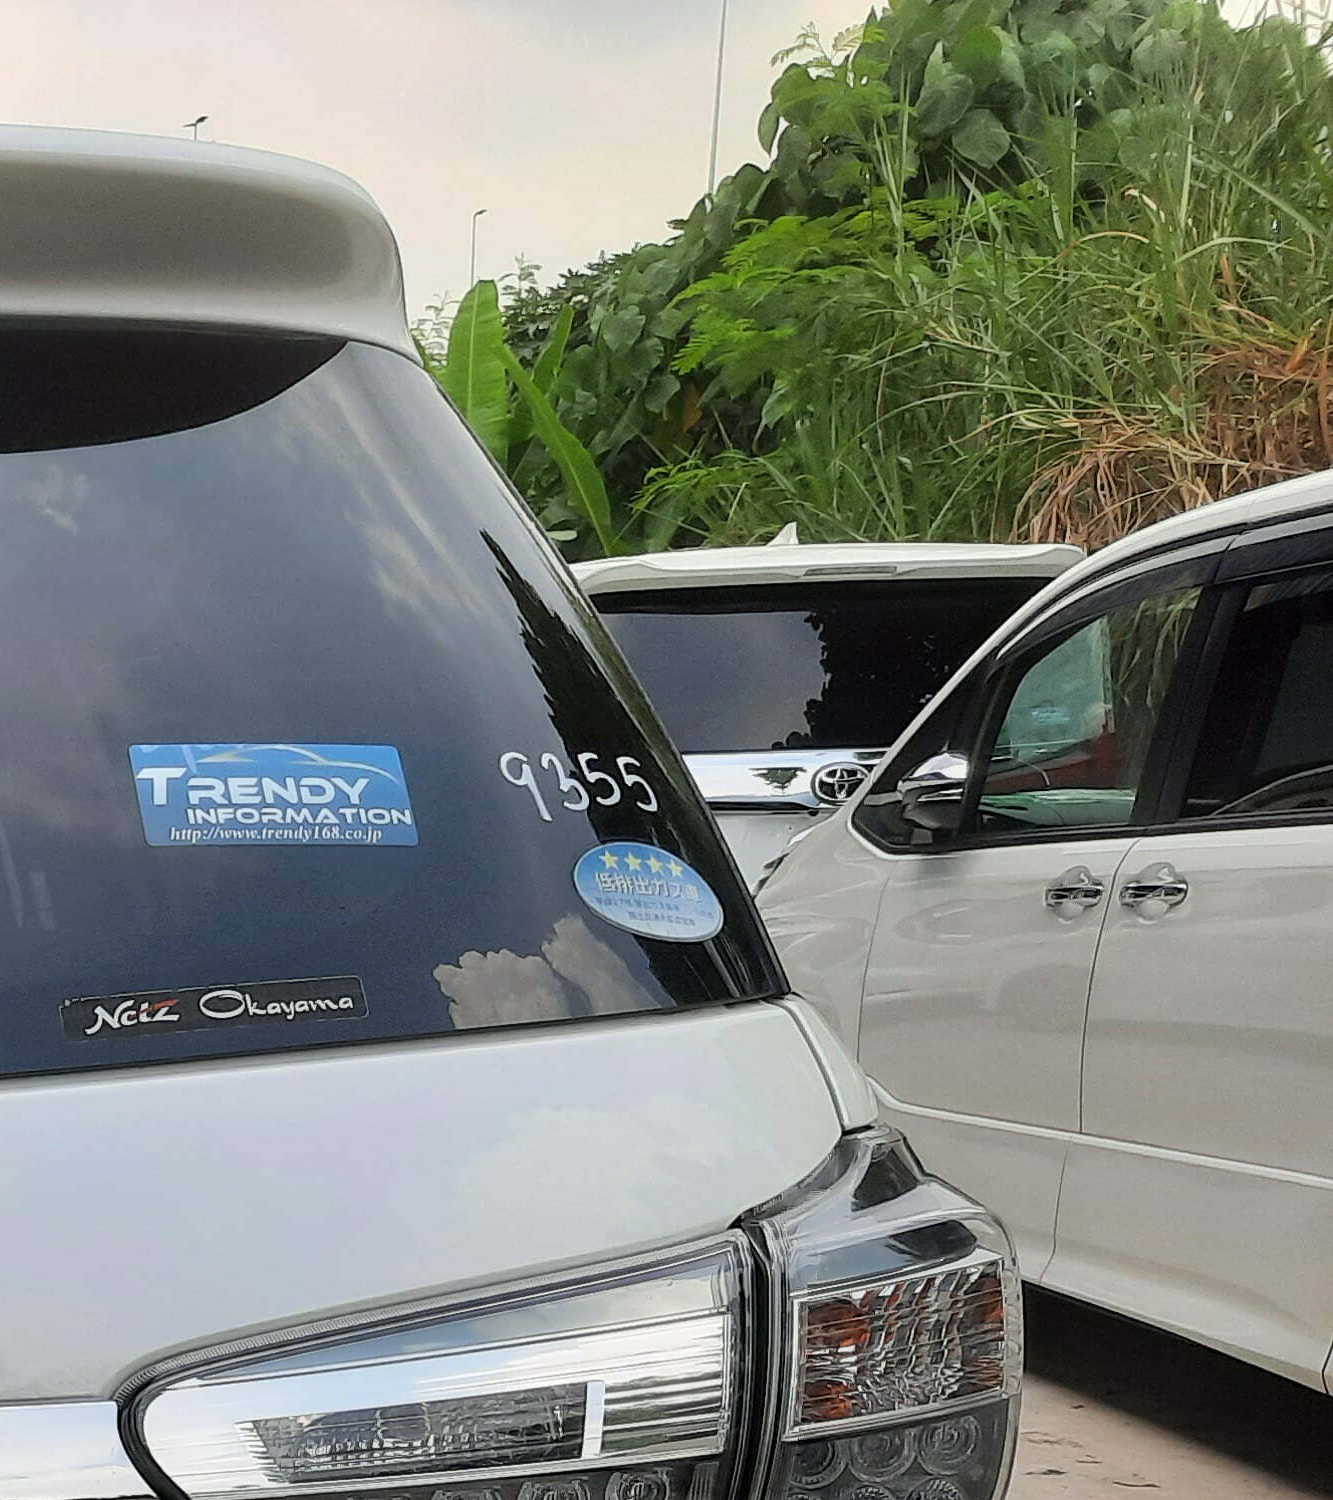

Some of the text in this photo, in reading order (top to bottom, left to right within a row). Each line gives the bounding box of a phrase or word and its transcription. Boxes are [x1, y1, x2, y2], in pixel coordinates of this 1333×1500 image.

[136, 767, 371, 806] TRENDY
[499, 751, 659, 822] 9355
[187, 808, 413, 825] INFORMATION
[170, 825, 383, 844] http://www.trendy168.co.jp
[199, 989, 355, 1020] Okayama
